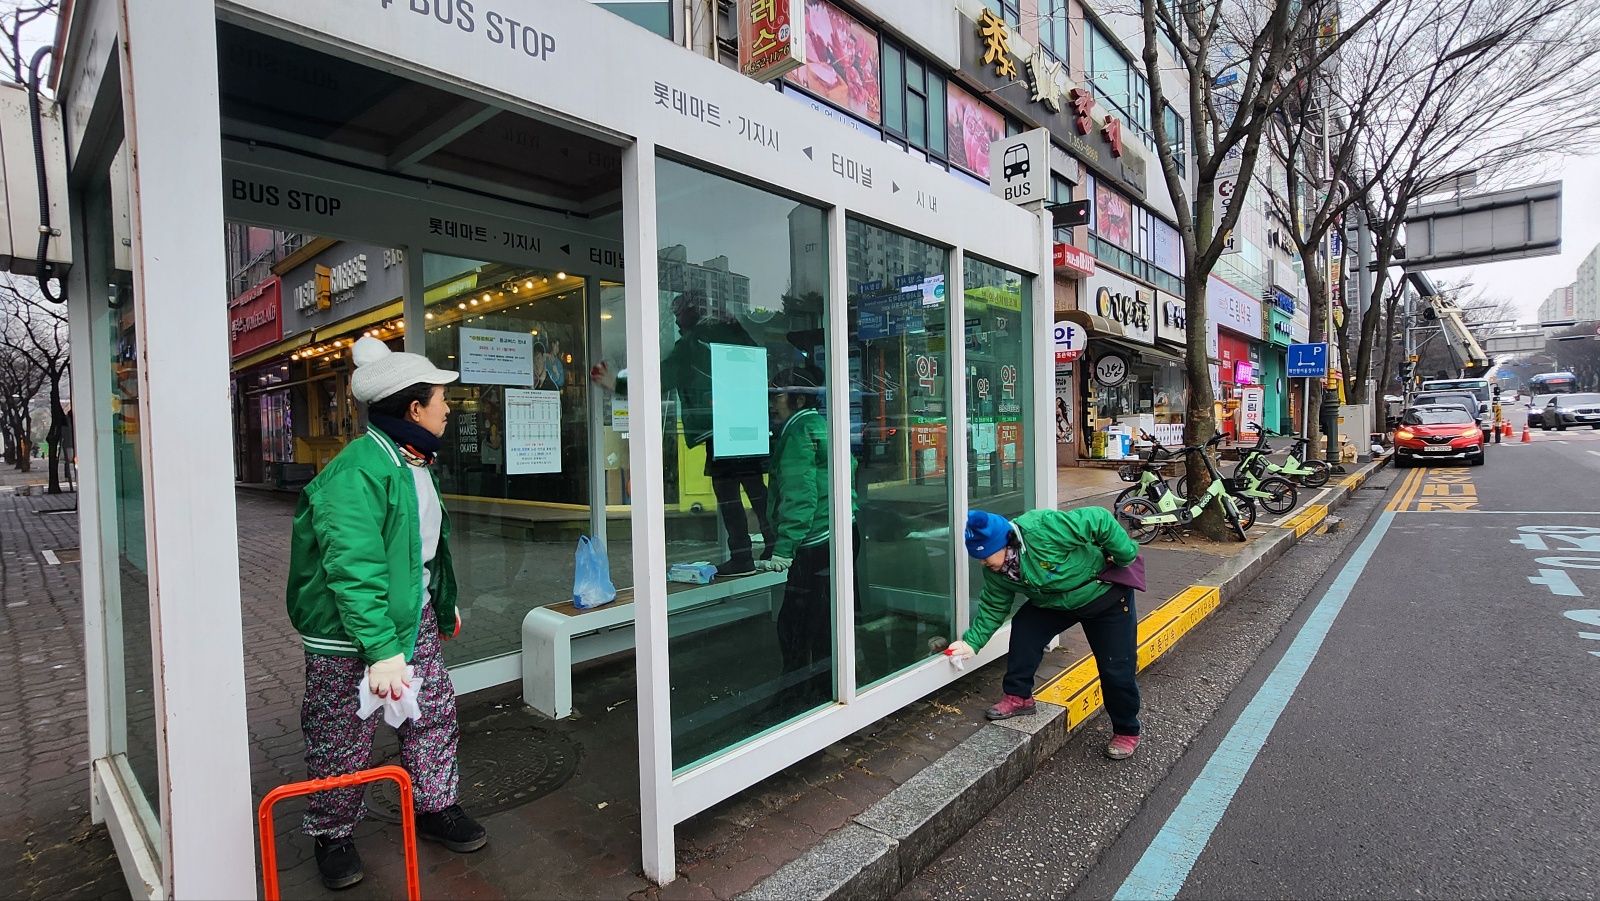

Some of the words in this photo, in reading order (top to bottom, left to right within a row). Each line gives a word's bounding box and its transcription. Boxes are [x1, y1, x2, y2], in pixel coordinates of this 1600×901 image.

[486, 10, 556, 62] STOP
[653, 80, 721, 128] 롯데마트
[738, 115, 779, 152] 기지시
[831, 152, 873, 189] 터미널
[231, 178, 281, 207] BUS
[287, 188, 342, 217] STOP
[1004, 183, 1031, 201] BUS
[428, 217, 487, 243] 롯데마트
[502, 231, 541, 254] 기지시
[1054, 327, 1075, 350] 약
[1313, 346, 1323, 356] P
[917, 355, 937, 396] 약
[1001, 365, 1016, 399] 약
[1098, 363, 1124, 378] 김밥
[977, 378, 989, 403] 약
[459, 425, 478, 436] MAKES
